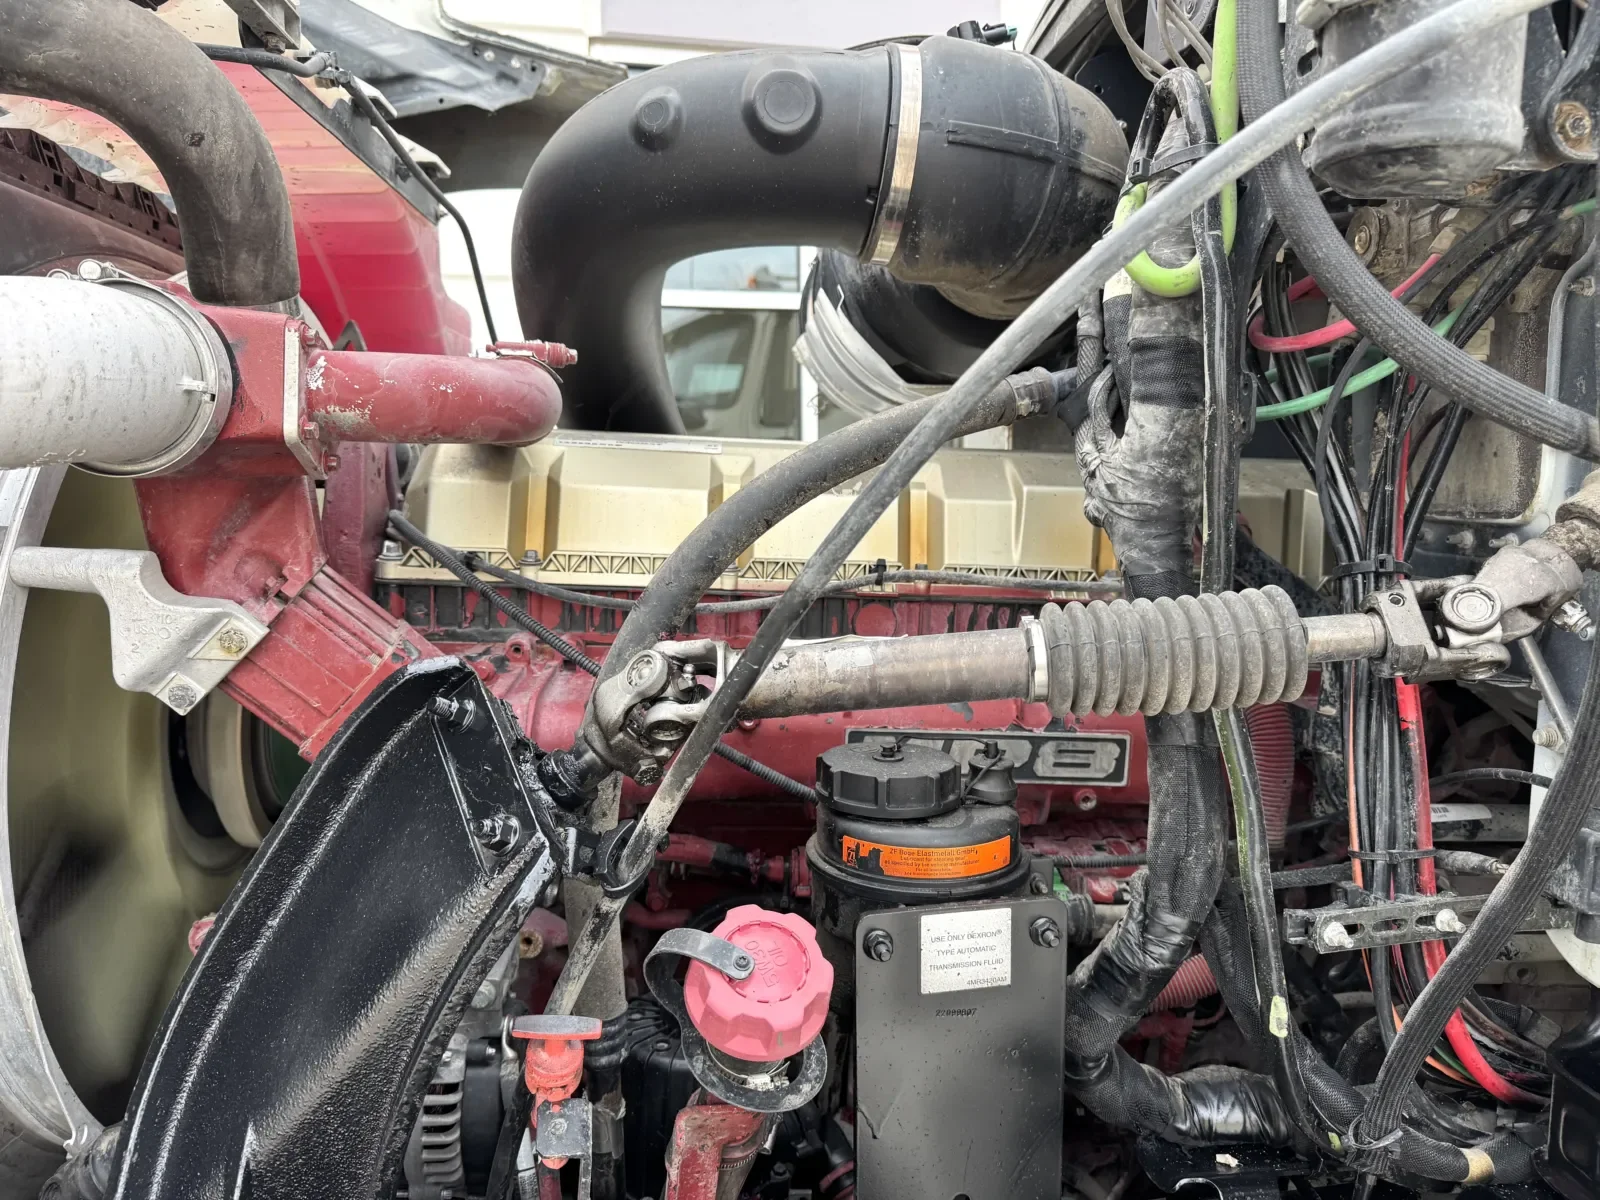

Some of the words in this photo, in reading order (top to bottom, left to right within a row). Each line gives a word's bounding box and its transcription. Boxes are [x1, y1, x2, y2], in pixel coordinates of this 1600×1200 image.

[930, 935, 946, 943] USE
[947, 933, 966, 942] ONLY
[937, 948, 955, 957] TYPE
[956, 945, 997, 955] AUTOMATIC
[929, 960, 982, 972] TRANSMISSION
[983, 957, 1004, 966] FLUID
